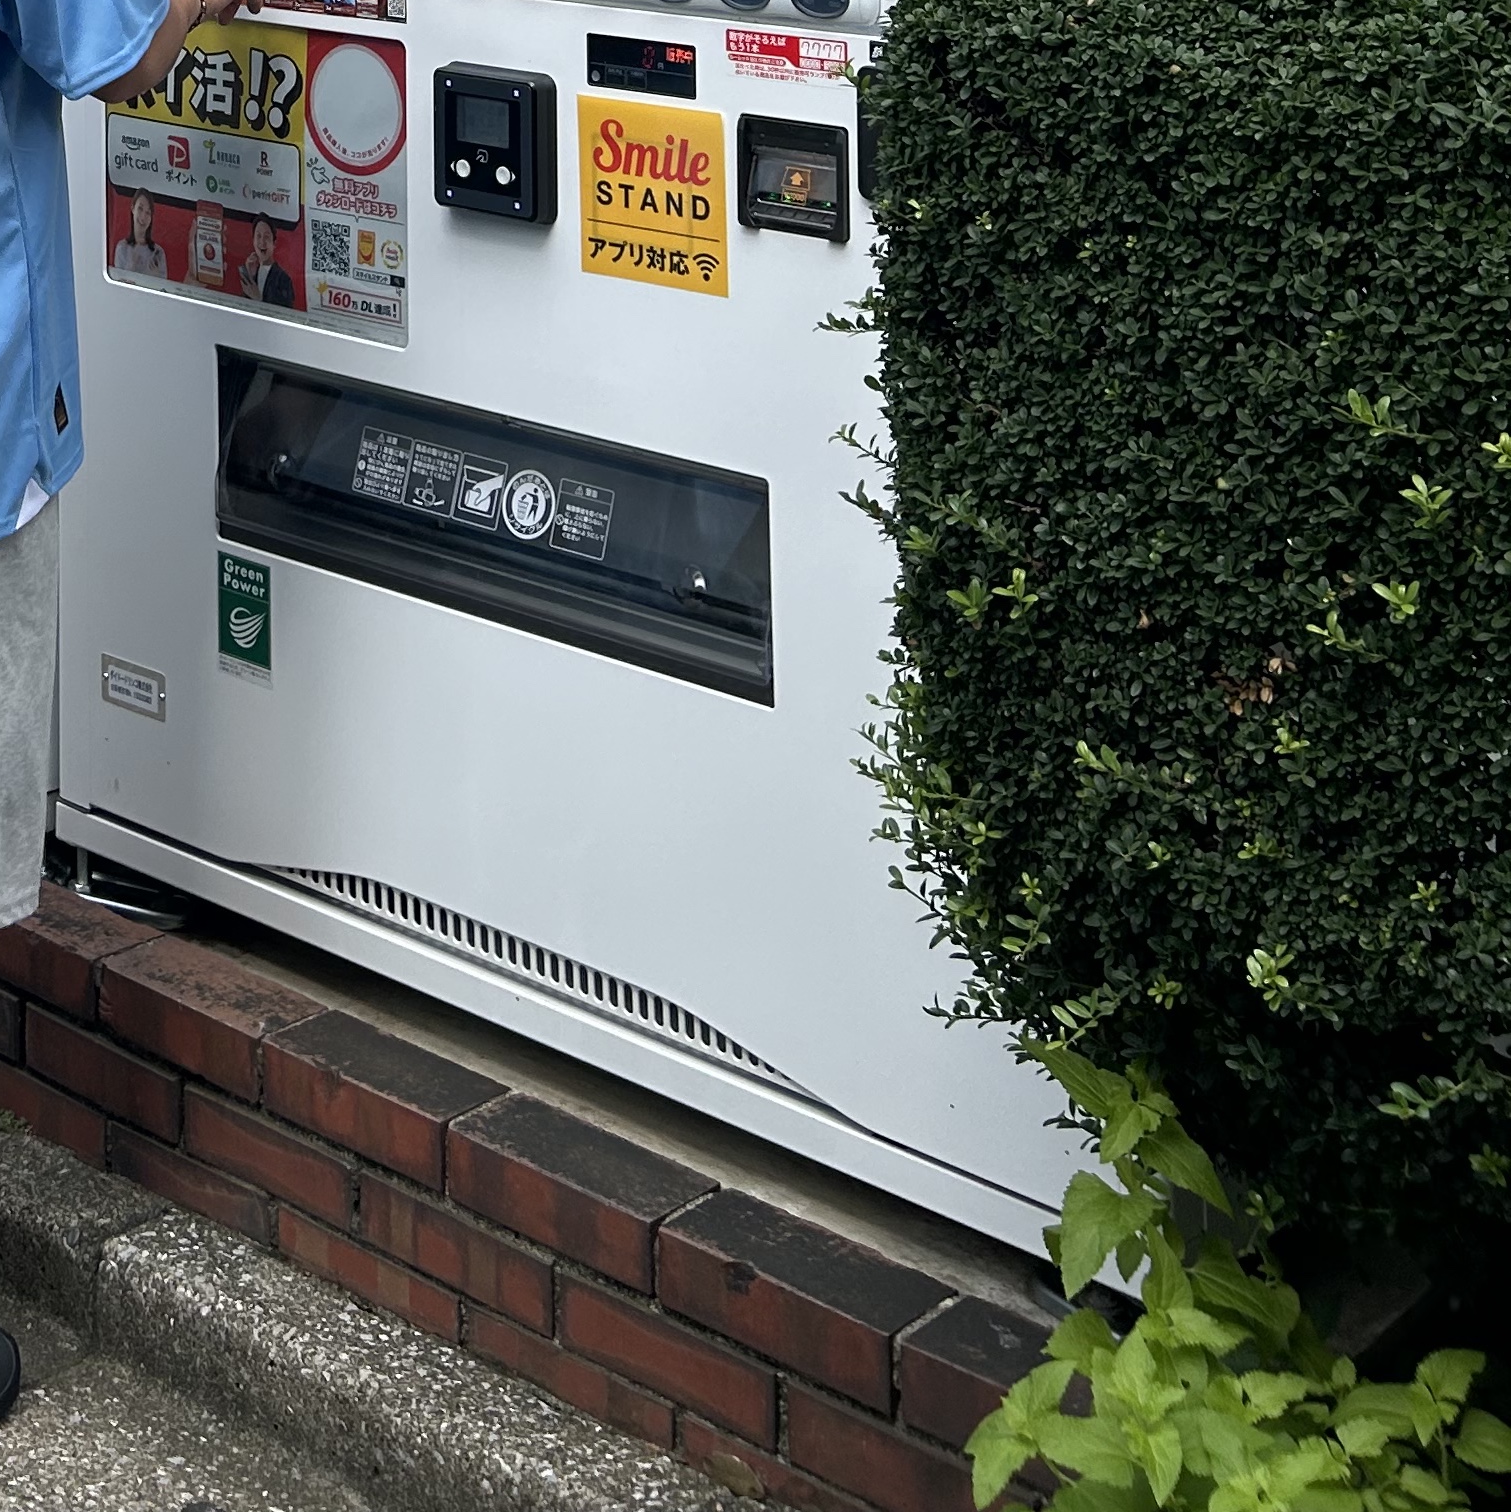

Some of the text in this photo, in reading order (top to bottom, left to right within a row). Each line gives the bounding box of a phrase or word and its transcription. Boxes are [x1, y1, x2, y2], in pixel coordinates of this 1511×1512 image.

[728, 30, 787, 47] 数字がそろえば
[728, 42, 761, 54] もう1本
[664, 45, 694, 66] 販売中
[800, 40, 844, 61] 7777
[133, 46, 302, 134] イ活!?
[120, 134, 151, 150] amazon
[593, 118, 712, 187] Smile
[114, 152, 159, 173] gift card
[259, 151, 269, 168] R
[165, 169, 198, 187] ポイント
[256, 167, 274, 177] POINT
[331, 175, 380, 200] 無料アプリ
[316, 191, 399, 219] ダウンロードはコチラ
[596, 180, 711, 222] STAND
[587, 236, 691, 277] アプリ対応
[327, 289, 359, 310] 160万
[223, 557, 265, 584] Green
[223, 572, 266, 598] Power
